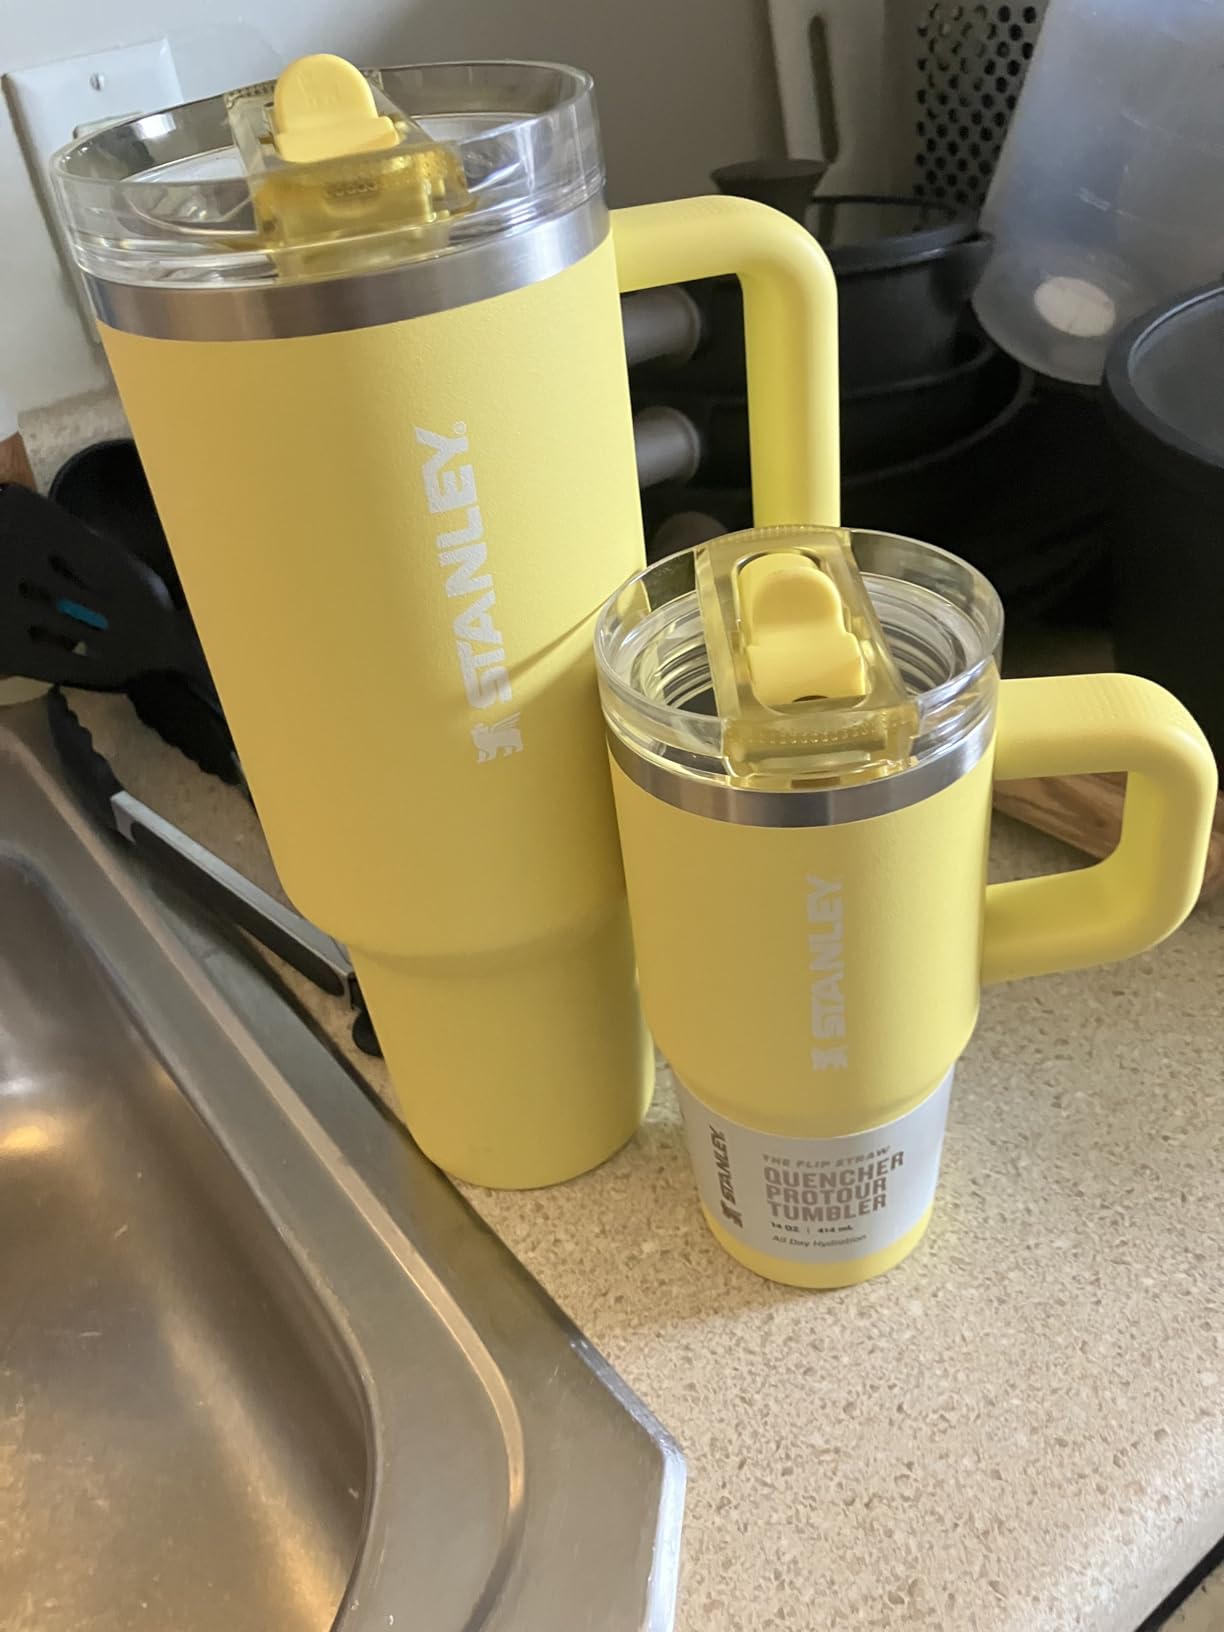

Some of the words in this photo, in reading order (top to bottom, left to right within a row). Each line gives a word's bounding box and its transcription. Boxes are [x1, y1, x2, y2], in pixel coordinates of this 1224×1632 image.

[805, 872, 846, 1039] STANLEY
[708, 1123, 736, 1206] STANLEY
[762, 1153, 791, 1167] THE
[795, 1159, 831, 1169] FLIP
[763, 1150, 904, 1189] QUENCHER
[765, 1176, 887, 1206] PROTOUR
[766, 1193, 887, 1222] TUMBLER
[771, 1234, 787, 1243] All
[789, 1237, 810, 1247] Day
